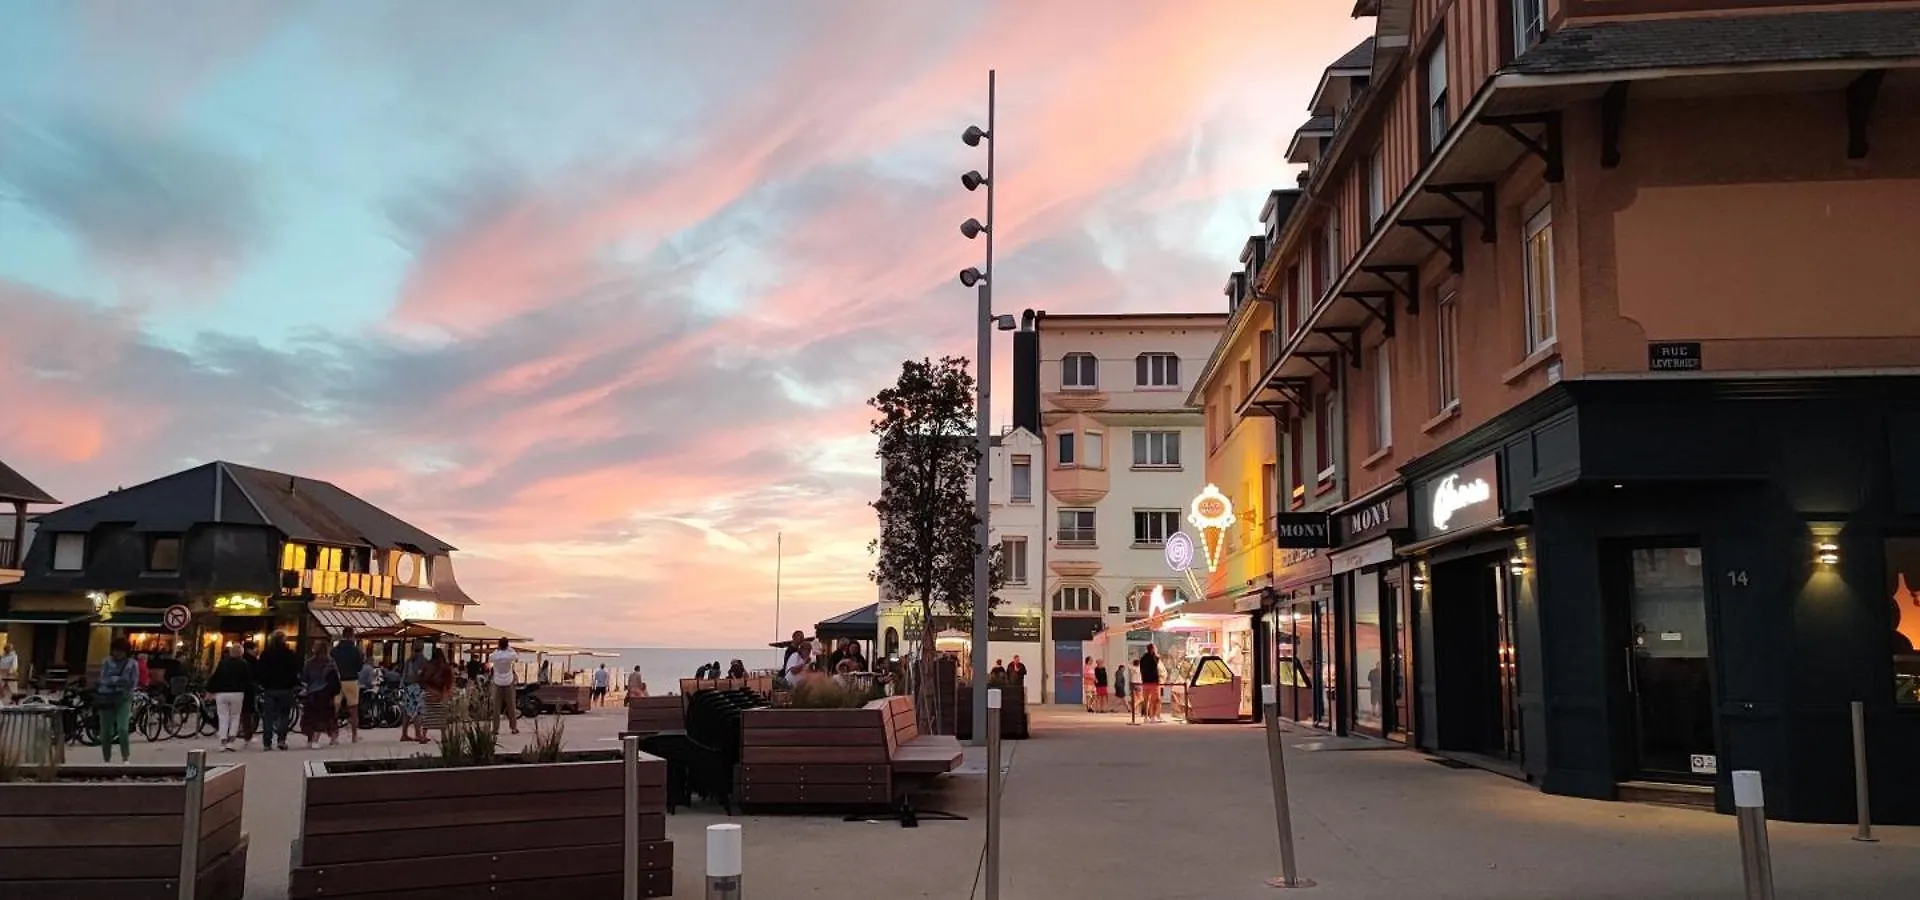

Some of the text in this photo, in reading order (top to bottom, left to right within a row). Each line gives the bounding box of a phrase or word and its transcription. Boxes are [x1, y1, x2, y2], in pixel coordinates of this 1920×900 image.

[1662, 346, 1688, 356] RUE
[1350, 499, 1391, 534] MONY
[1280, 524, 1326, 537] MONY
[1727, 571, 1748, 586] 14
